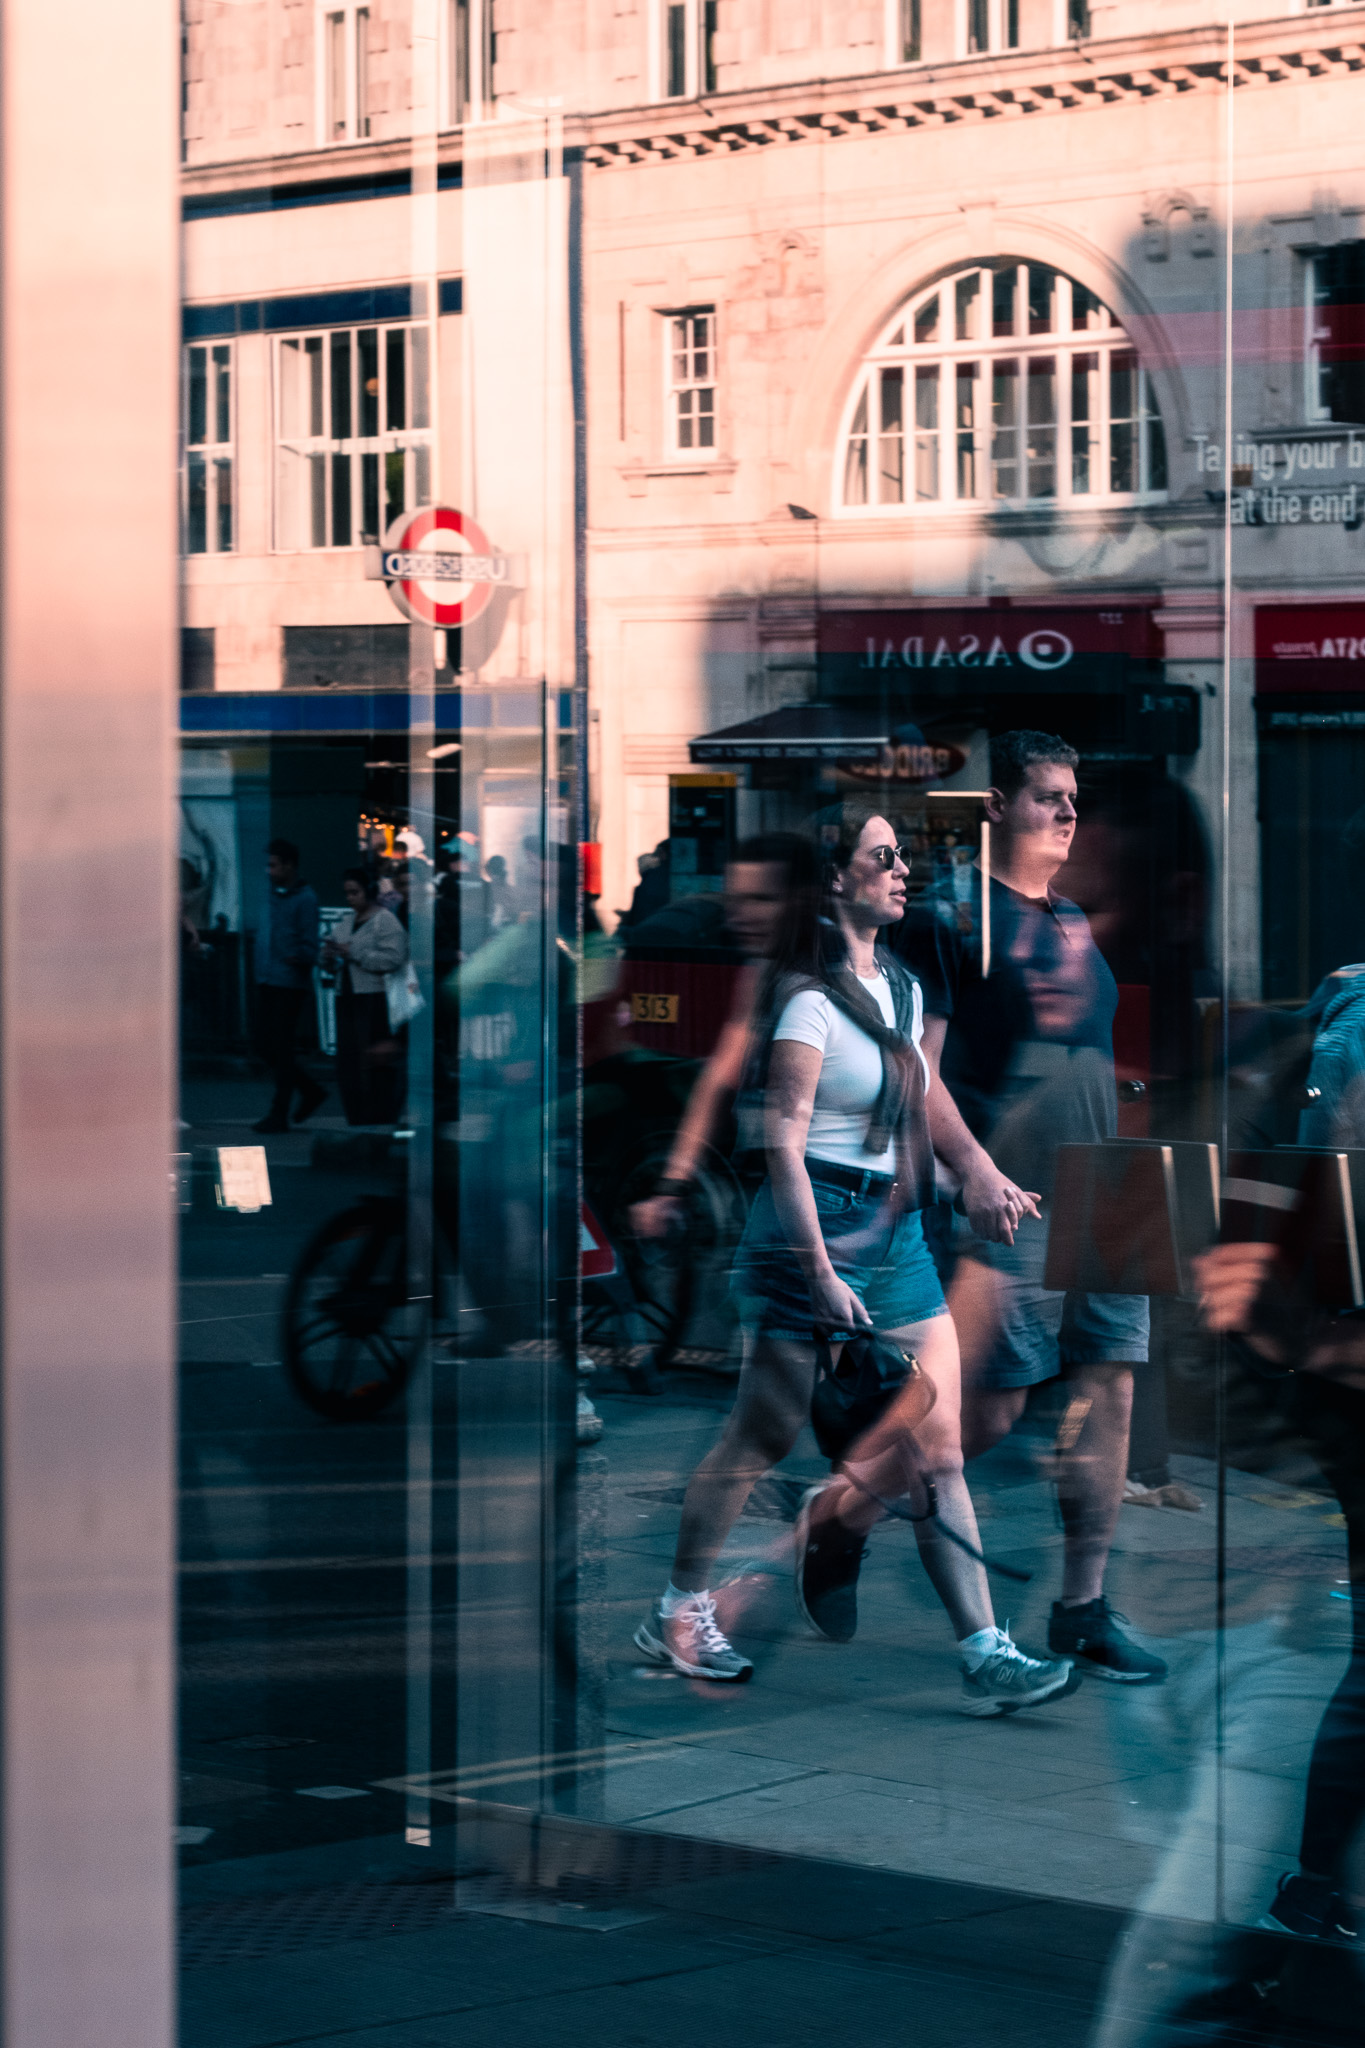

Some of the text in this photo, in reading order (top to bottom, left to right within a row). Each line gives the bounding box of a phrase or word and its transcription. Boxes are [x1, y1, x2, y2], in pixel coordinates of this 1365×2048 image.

[1191, 434, 1275, 481] Taing
[1283, 441, 1341, 480] your
[1230, 489, 1256, 524] at
[1262, 487, 1301, 523] the
[1309, 485, 1357, 522] end
